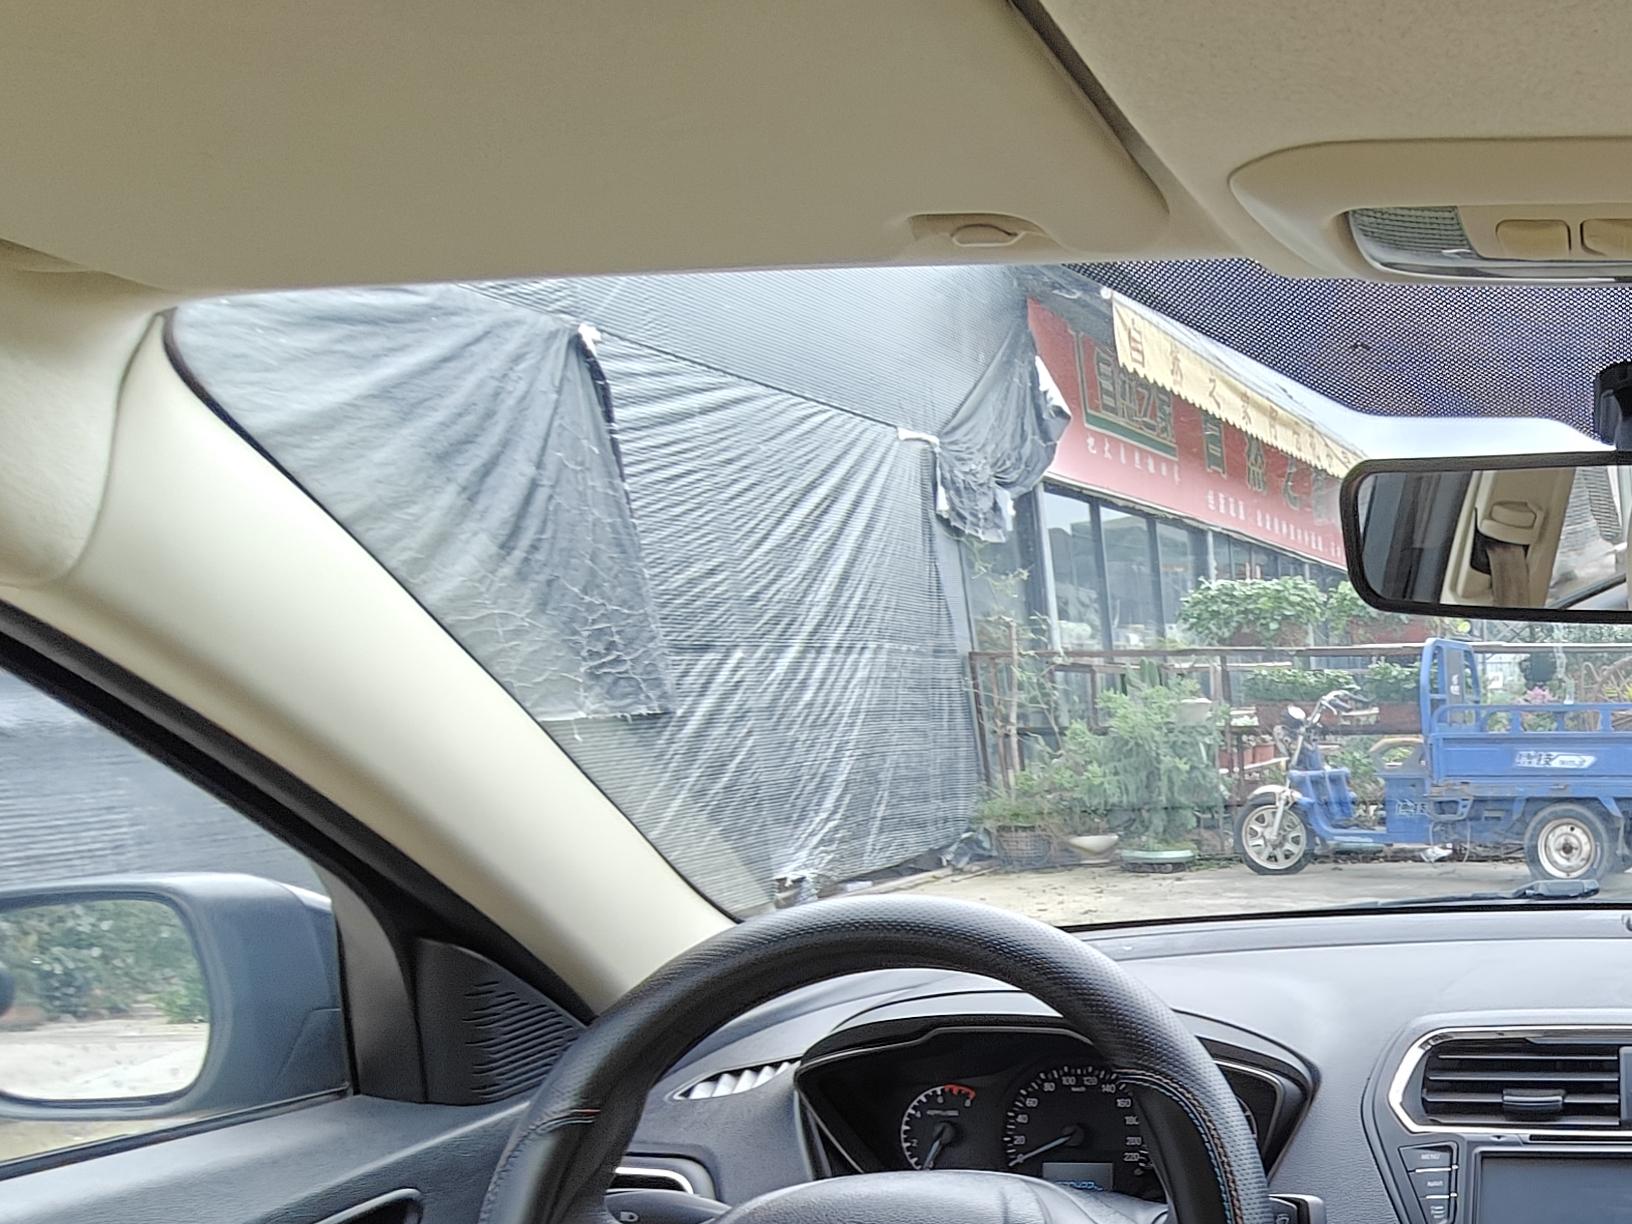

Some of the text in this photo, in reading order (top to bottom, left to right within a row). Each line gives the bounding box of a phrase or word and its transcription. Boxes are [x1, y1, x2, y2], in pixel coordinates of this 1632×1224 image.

[1061, 1076, 1077, 1085] 100
[1082, 1076, 1098, 1086] 120
[1043, 1082, 1056, 1092] 80
[1101, 1083, 1117, 1094] 140
[1025, 1097, 1038, 1107] 60
[1116, 1098, 1132, 1108] 160
[1016, 1114, 1029, 1123] 40
[1013, 1135, 1026, 1145] 20
[1123, 1152, 1140, 1162] 220
